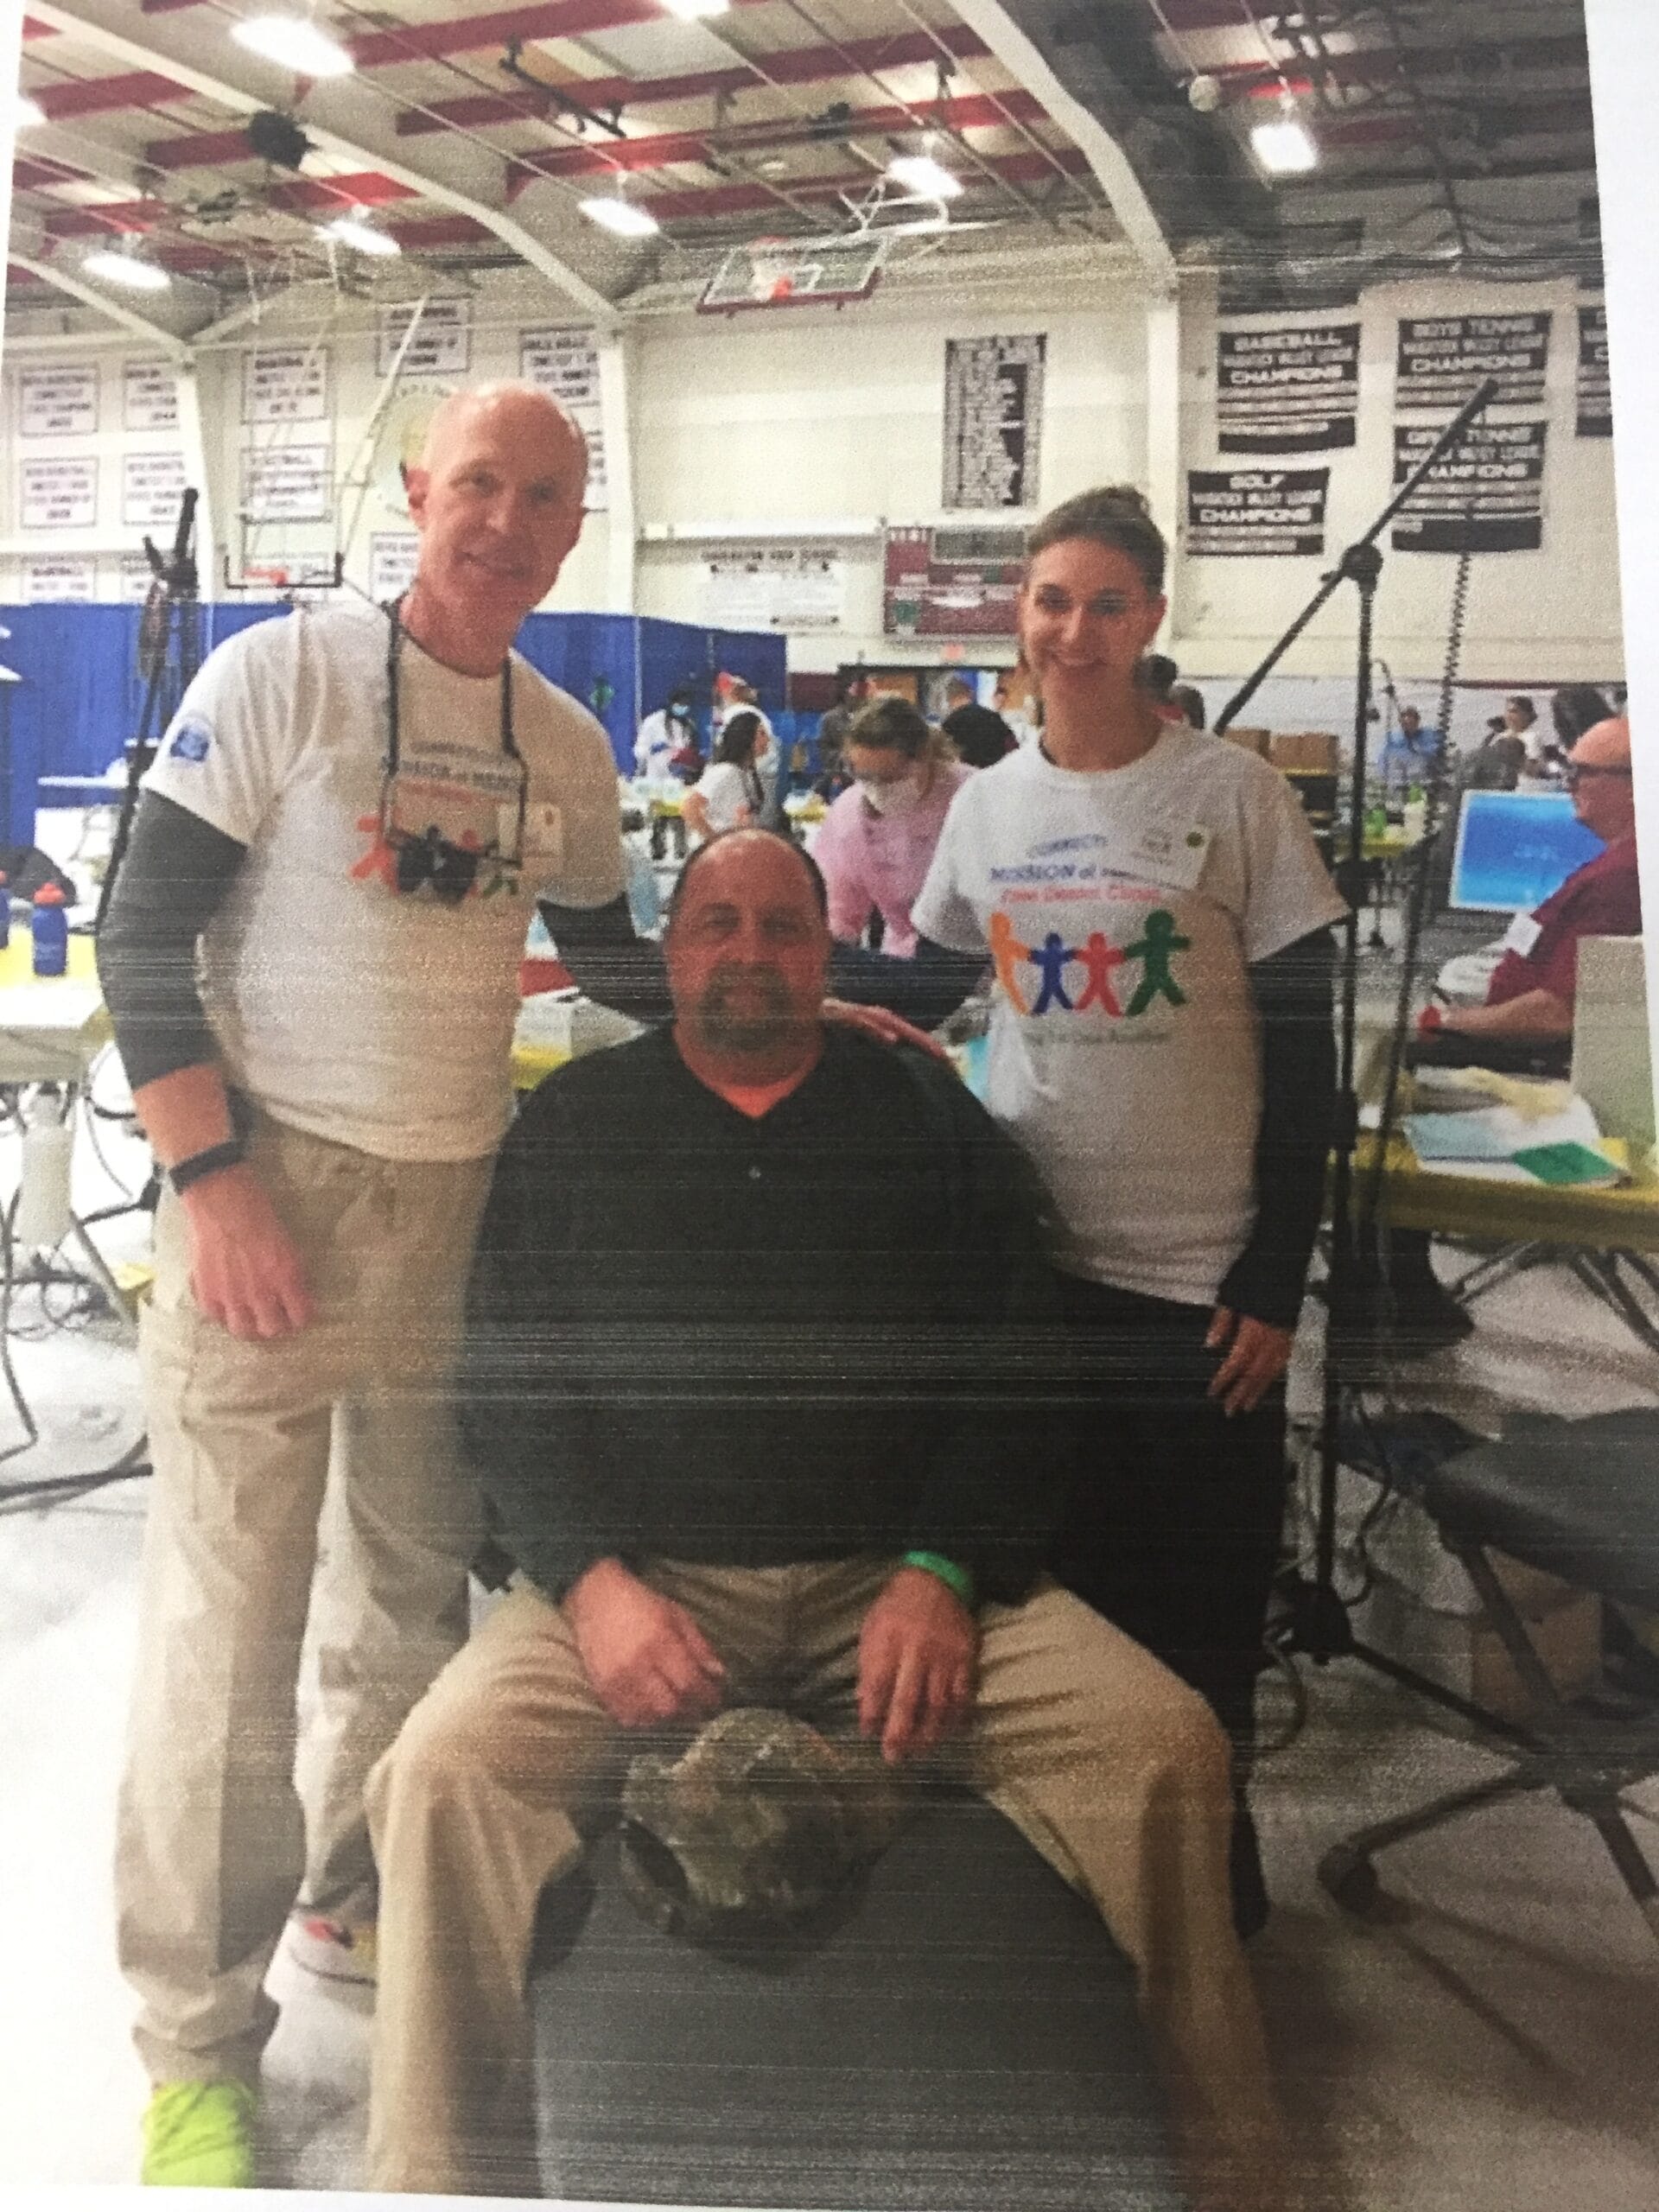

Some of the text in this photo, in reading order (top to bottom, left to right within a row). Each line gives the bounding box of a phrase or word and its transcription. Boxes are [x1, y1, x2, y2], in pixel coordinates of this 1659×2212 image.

[1234, 333, 1342, 352] BASEBALL
[1411, 353, 1530, 372] CHAMPIONS
[1230, 365, 1343, 384] CHAMPIONS
[1230, 474, 1286, 490] GOLF
[1199, 507, 1312, 523] CHAMPIONS
